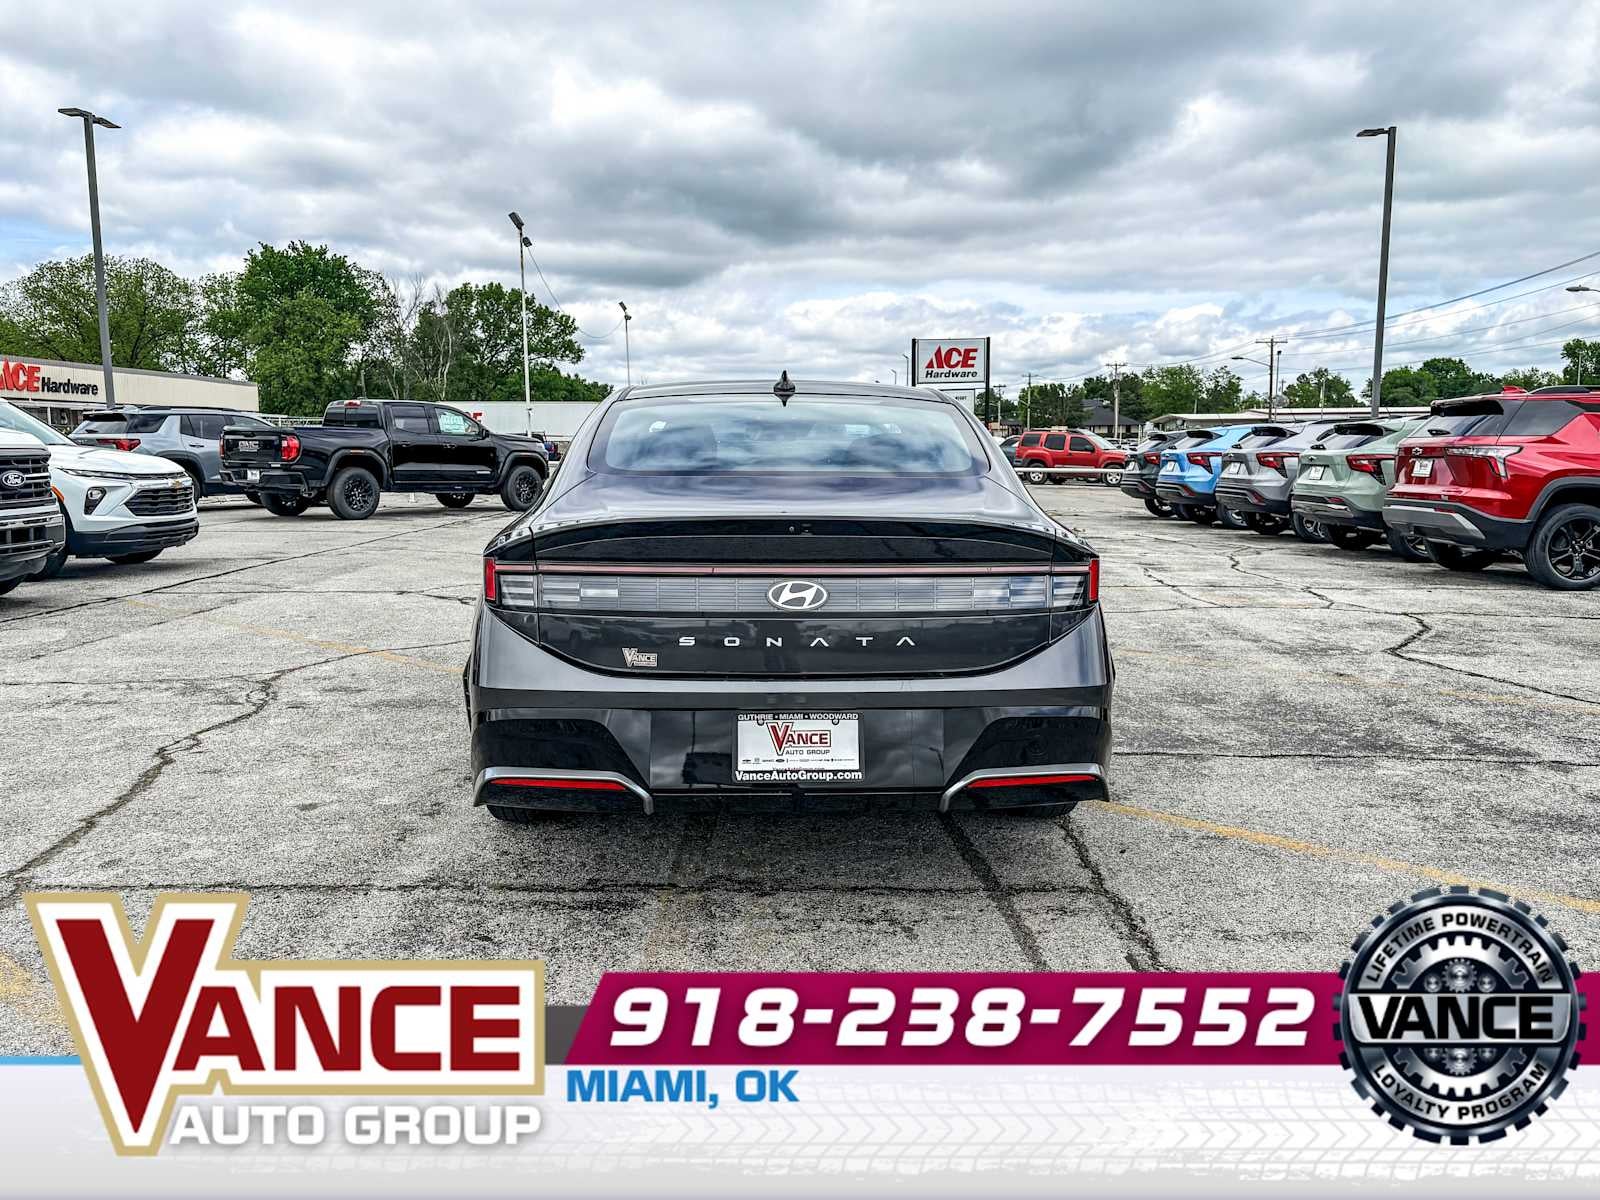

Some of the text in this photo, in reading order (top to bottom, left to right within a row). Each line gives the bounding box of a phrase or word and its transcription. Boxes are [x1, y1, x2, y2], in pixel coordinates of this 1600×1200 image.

[925, 345, 978, 369] ACE
[0, 357, 99, 396] ACE Hardware
[925, 370, 978, 379] Hardware
[678, 636, 916, 647] SONATA
[768, 724, 829, 752] VANCE
[735, 771, 862, 781] VanceAutoGroup.com
